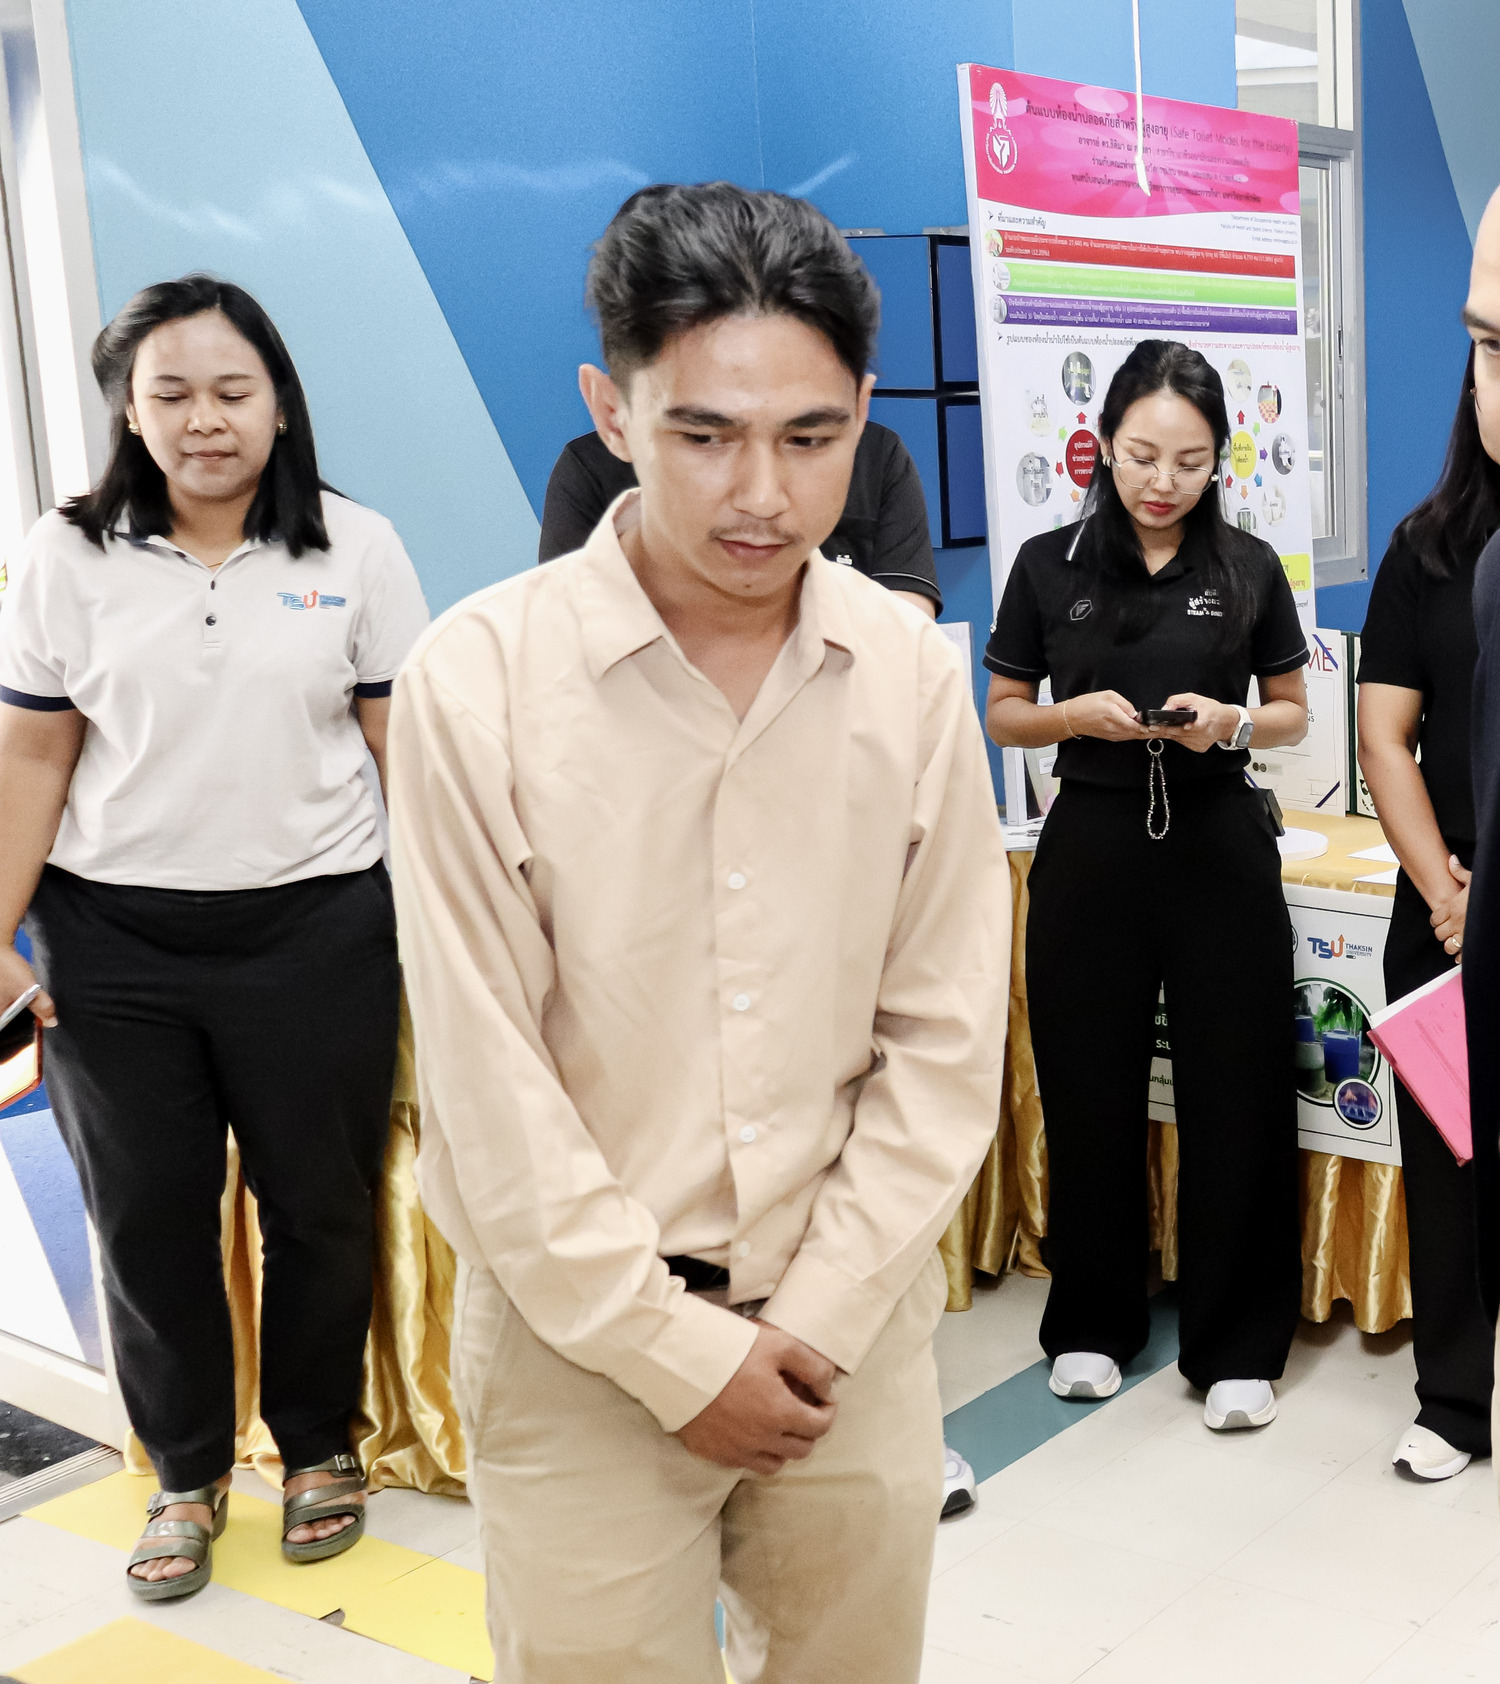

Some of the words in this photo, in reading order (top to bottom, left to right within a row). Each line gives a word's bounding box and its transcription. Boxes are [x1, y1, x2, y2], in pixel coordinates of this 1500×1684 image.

[1026, 100, 1169, 140] ต้นแบบห้องน้ำปลอดภัยสำหรัู้สูงอายุ
[277, 590, 319, 610] TSU
[1307, 646, 1334, 672] ME
[1307, 934, 1345, 960] TSU
[1345, 942, 1373, 952] THAKSIN
